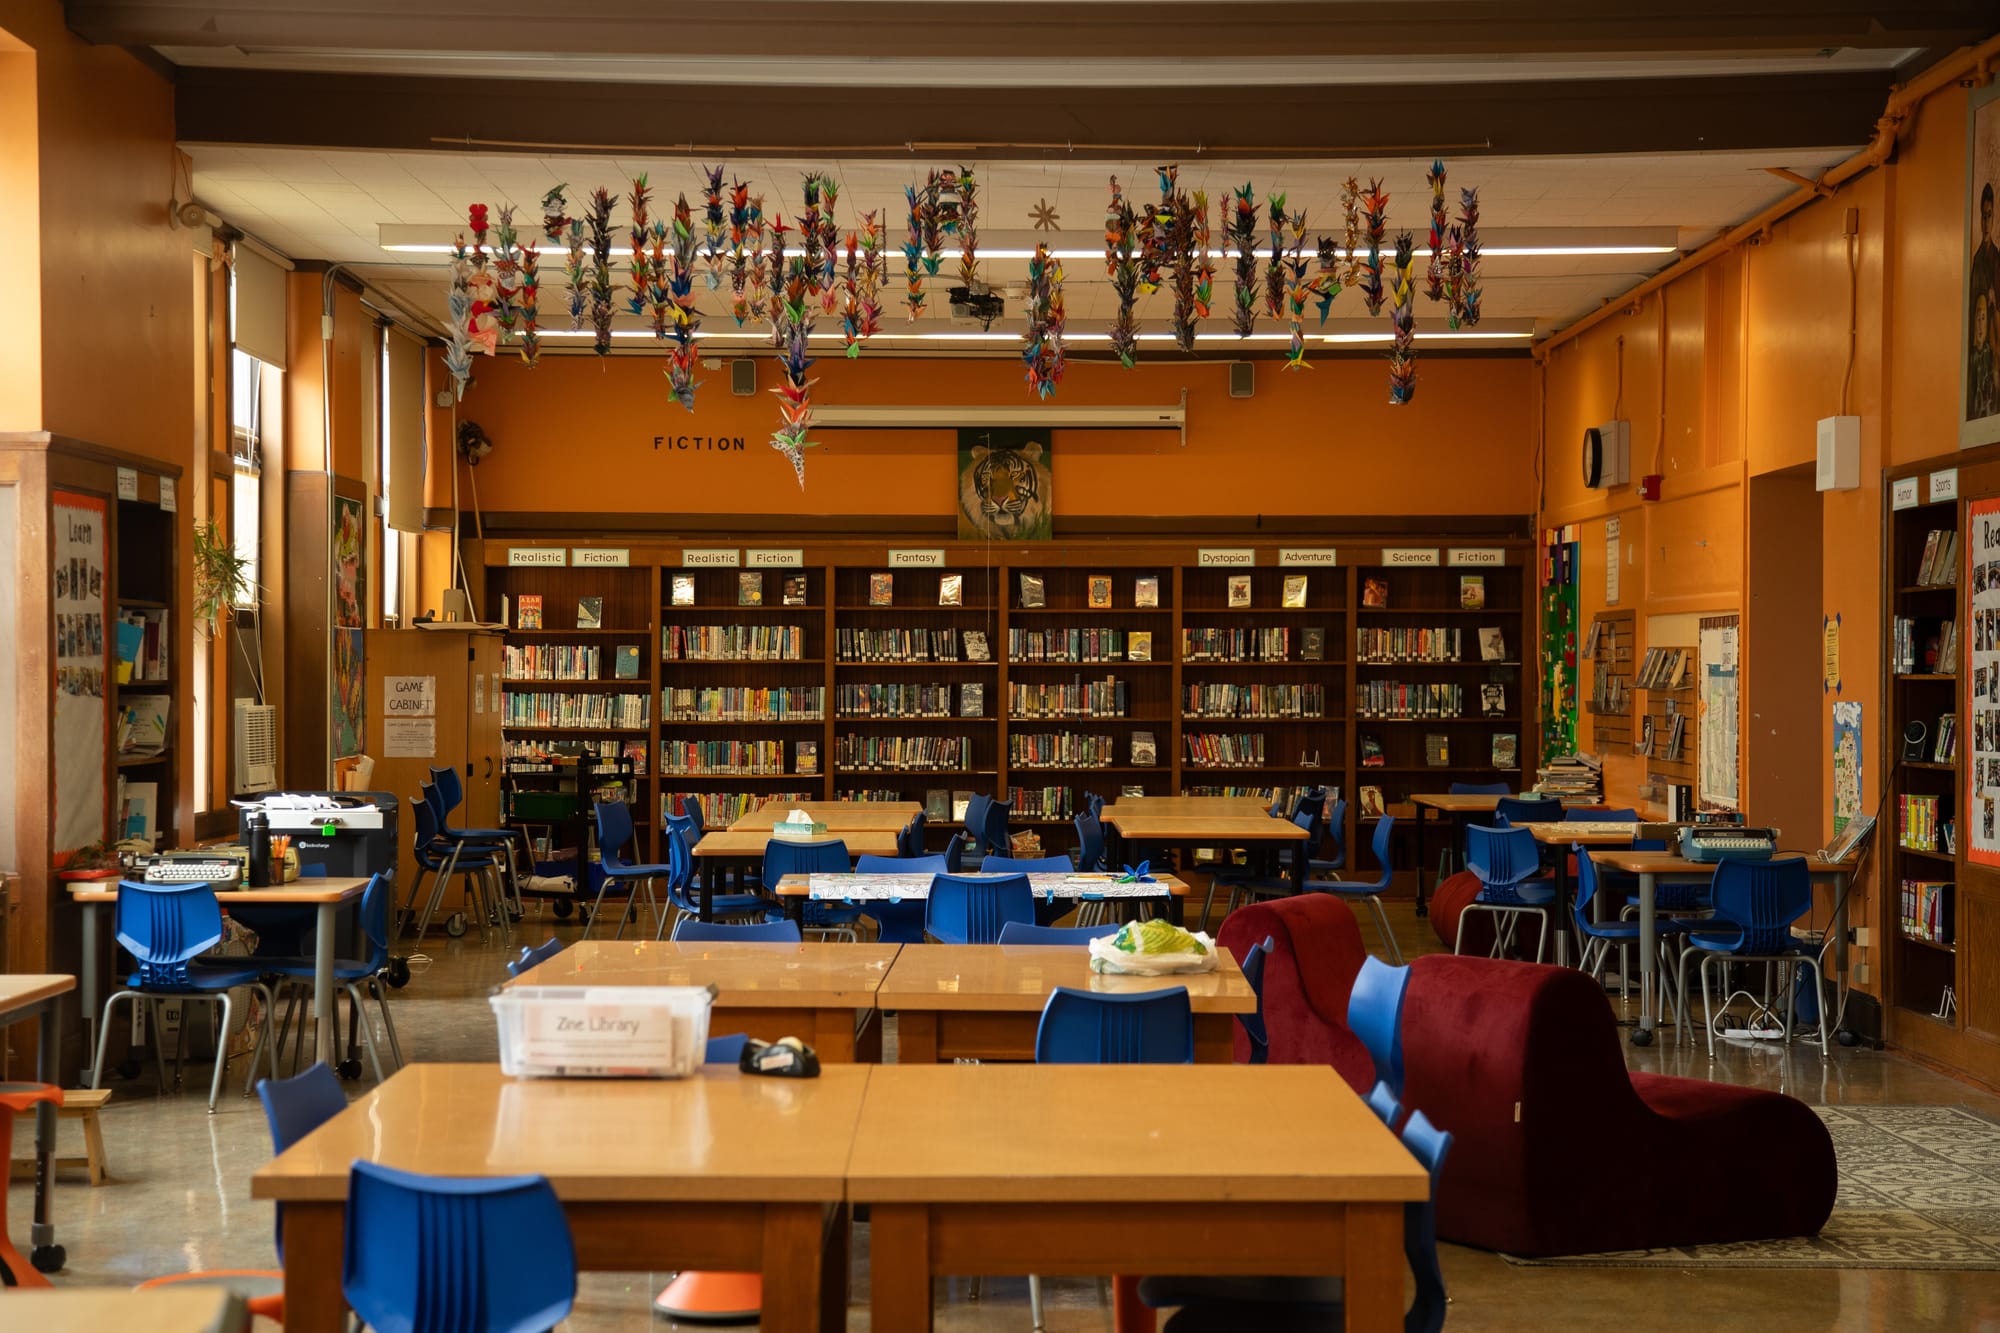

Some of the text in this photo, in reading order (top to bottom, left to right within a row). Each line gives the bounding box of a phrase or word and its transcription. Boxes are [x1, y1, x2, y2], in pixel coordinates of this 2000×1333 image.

[654, 436, 745, 451] FICTION
[1935, 479, 1951, 495] Sports
[68, 514, 92, 545] Learn
[513, 552, 619, 562] Realistic Fiction
[687, 553, 794, 563] Realistic Fiction
[896, 553, 937, 564] Fantasy
[1202, 553, 1250, 565] Dystopian
[1284, 552, 1332, 561] Adventure
[1392, 552, 1496, 562] Science Fiction
[395, 682, 424, 692] GAME
[389, 699, 432, 710] CABINET
[557, 1016, 640, 1036] Zine Library
